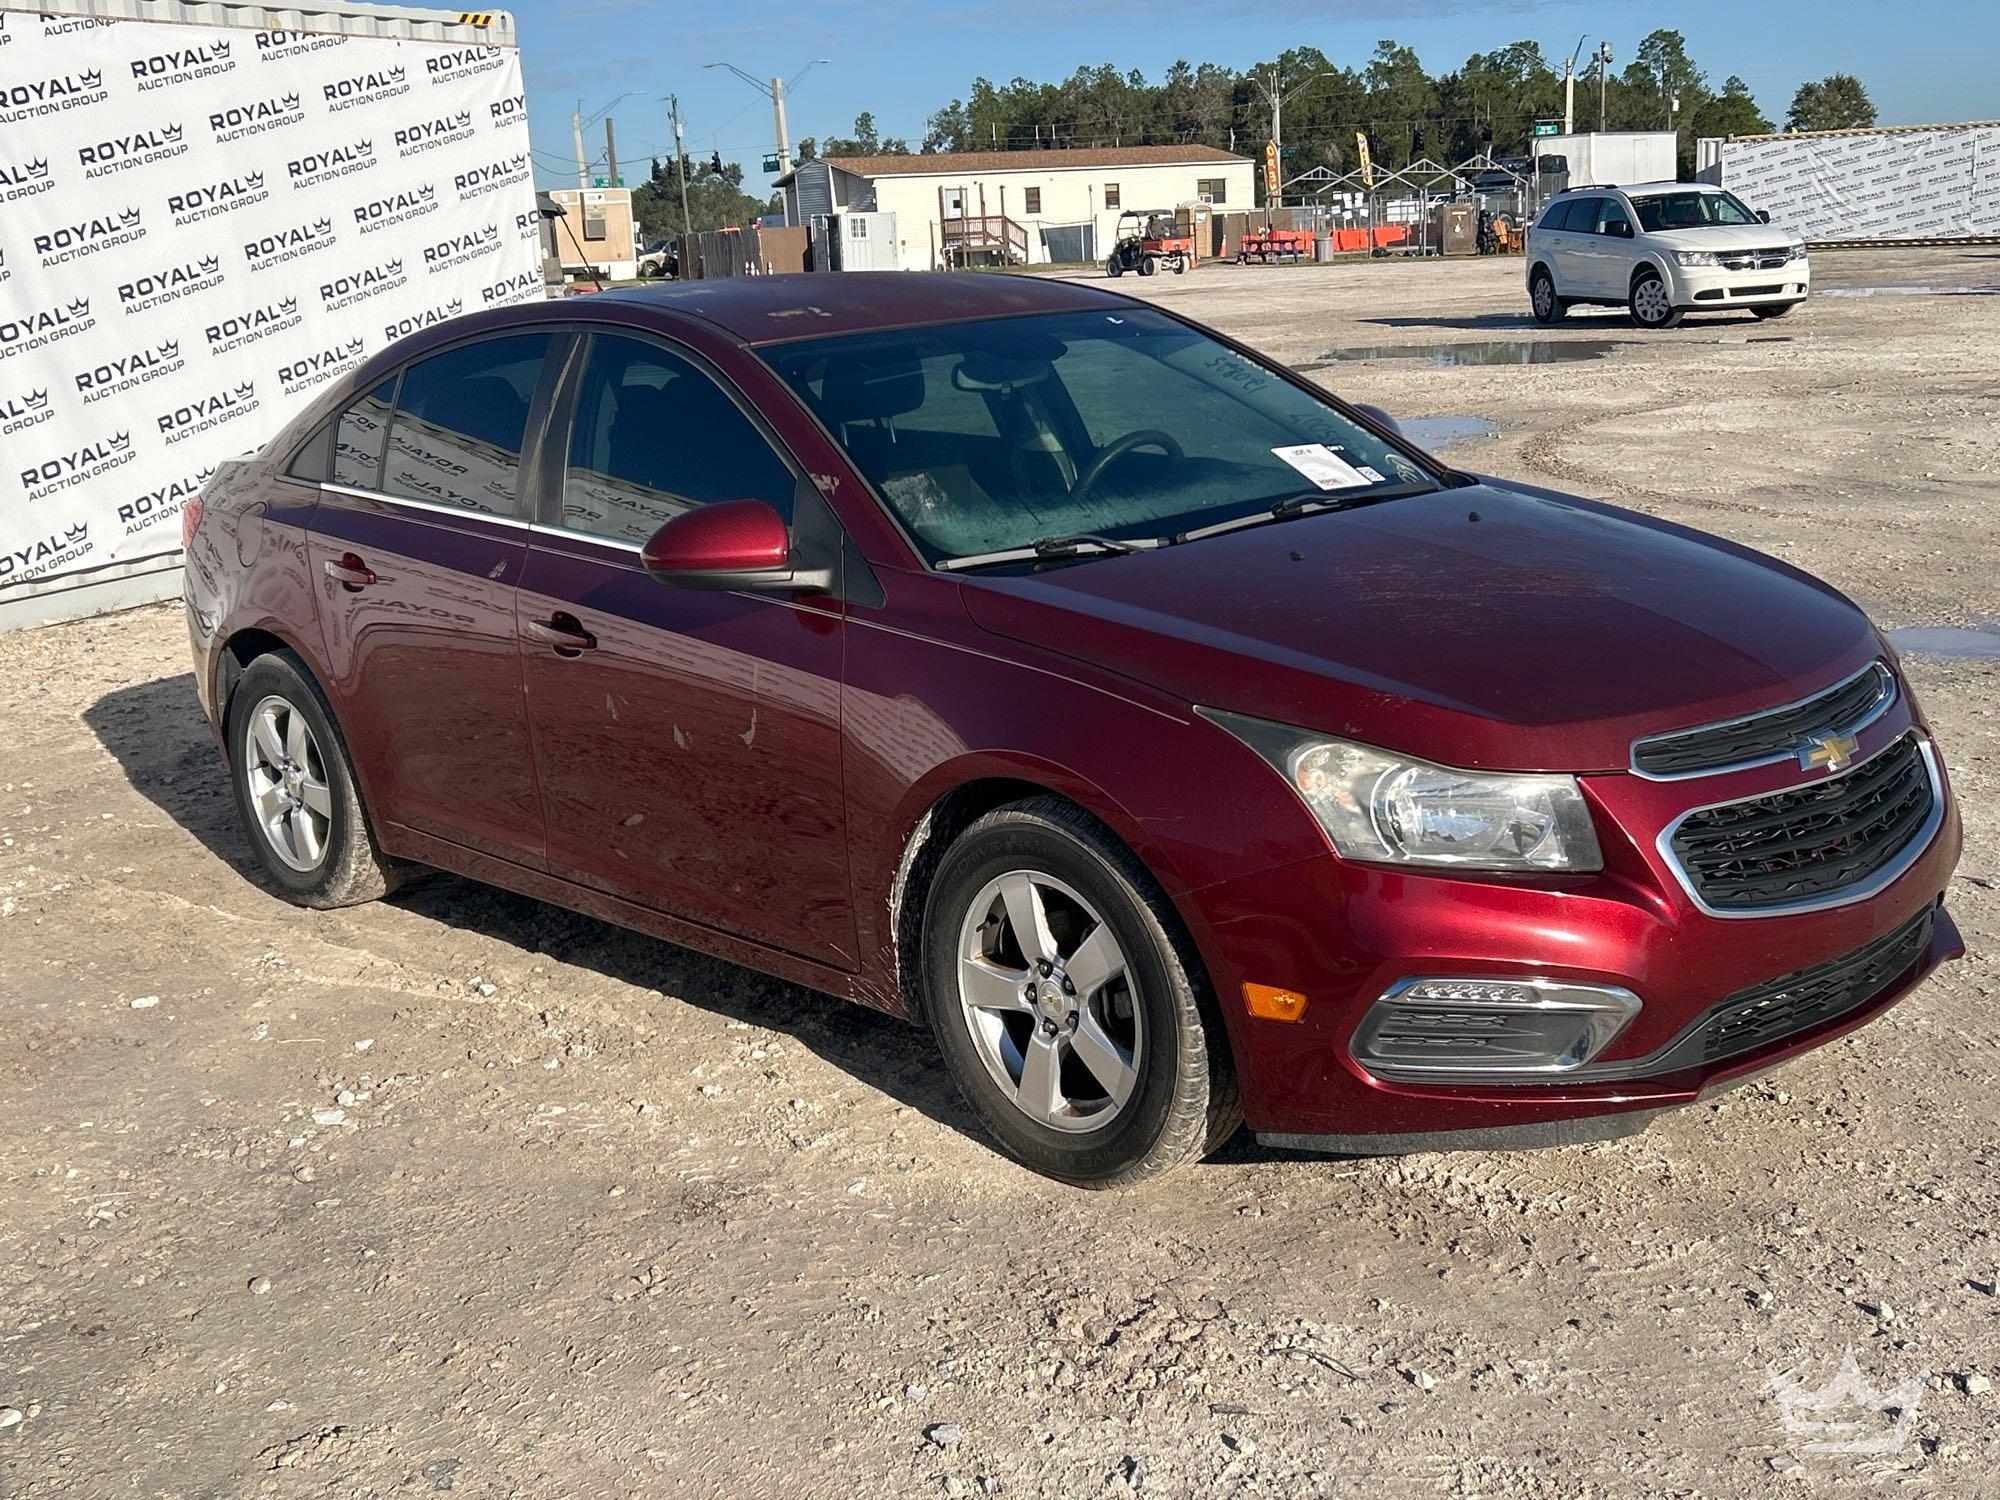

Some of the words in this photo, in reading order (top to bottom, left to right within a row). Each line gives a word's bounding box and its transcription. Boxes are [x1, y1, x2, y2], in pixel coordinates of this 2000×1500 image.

[255, 32, 319, 49] ROY
[262, 44, 309, 62] AUCTION
[311, 35, 348, 50] GROUP
[130, 47, 213, 78] ROYAL
[138, 71, 193, 92] AUCTION
[194, 61, 236, 78] GROUP
[426, 47, 487, 74] ROYAL
[432, 68, 472, 85] AUCTION
[473, 59, 504, 74] GROUP
[62, 91, 108, 110] GROUP
[323, 72, 390, 101] ROYAL
[329, 94, 374, 113] AUCTION
[375, 84, 410, 100] GROUP
[209, 99, 284, 131] ROYAL
[216, 123, 266, 144] AUCTION
[267, 112, 304, 129] GROUP
[394, 117, 457, 146] ROYAL
[400, 138, 442, 158] AUCTION
[443, 129, 474, 144] GROUP
[78, 131, 164, 166] ROYAL
[86, 156, 142, 179] AUCTION
[144, 144, 188, 163] GROUP
[287, 146, 357, 178] ROYAL
[6, 180, 55, 200] GROUP
[294, 169, 340, 190] AUCTION
[341, 158, 377, 175] GROUP
[454, 161, 512, 190] ROYAL
[460, 182, 498, 201] AUCTION
[500, 172, 529, 187] GROUP
[168, 179, 247, 214] ROYAL
[176, 204, 228, 227] AUCTION
[230, 191, 268, 210] GROUP
[354, 192, 420, 223] ROYAL
[360, 214, 404, 235] AUCTION
[405, 202, 438, 220] GROUP
[34, 216, 121, 254] ROYAL
[43, 242, 100, 268] AUCTION
[102, 228, 146, 249] GROUP
[244, 226, 315, 260] ROYAL
[424, 232, 484, 263] ROYAL
[251, 249, 298, 272] AUCTION
[300, 236, 336, 255] GROUP
[429, 254, 470, 274] AUCTION
[471, 242, 502, 258] GROUP
[118, 264, 201, 303] ROYAL
[126, 290, 180, 316] AUCTION
[182, 275, 224, 295] GROUP
[320, 266, 388, 301] ROYAL
[327, 290, 371, 313] AUCTION
[373, 276, 407, 295] GROUP
[482, 271, 538, 302] ROYAL
[488, 294, 524, 308] CTION
[50, 318, 96, 341] GROUP
[205, 306, 280, 344] ROYAL
[212, 330, 263, 356] AUCTION
[264, 315, 302, 336] GROUP
[385, 307, 448, 341] ROYAL
[75, 350, 160, 392] ROYAL
[278, 347, 349, 384] ROYAL
[84, 376, 140, 405] AUCTION
[141, 360, 185, 382] GROUP
[285, 371, 331, 396] AUCTION
[3, 410, 54, 434] GROUP
[157, 392, 236, 433] ROYAL
[166, 417, 218, 446] AUCTION
[219, 400, 260, 423] GROUP
[21, 443, 110, 488] ROYAL
[30, 470, 91, 502] AUCTION
[92, 451, 137, 476] GROUP
[118, 478, 198, 523] ROYAL
[126, 505, 178, 536] AUCTION
[48, 542, 93, 569] GROUP
